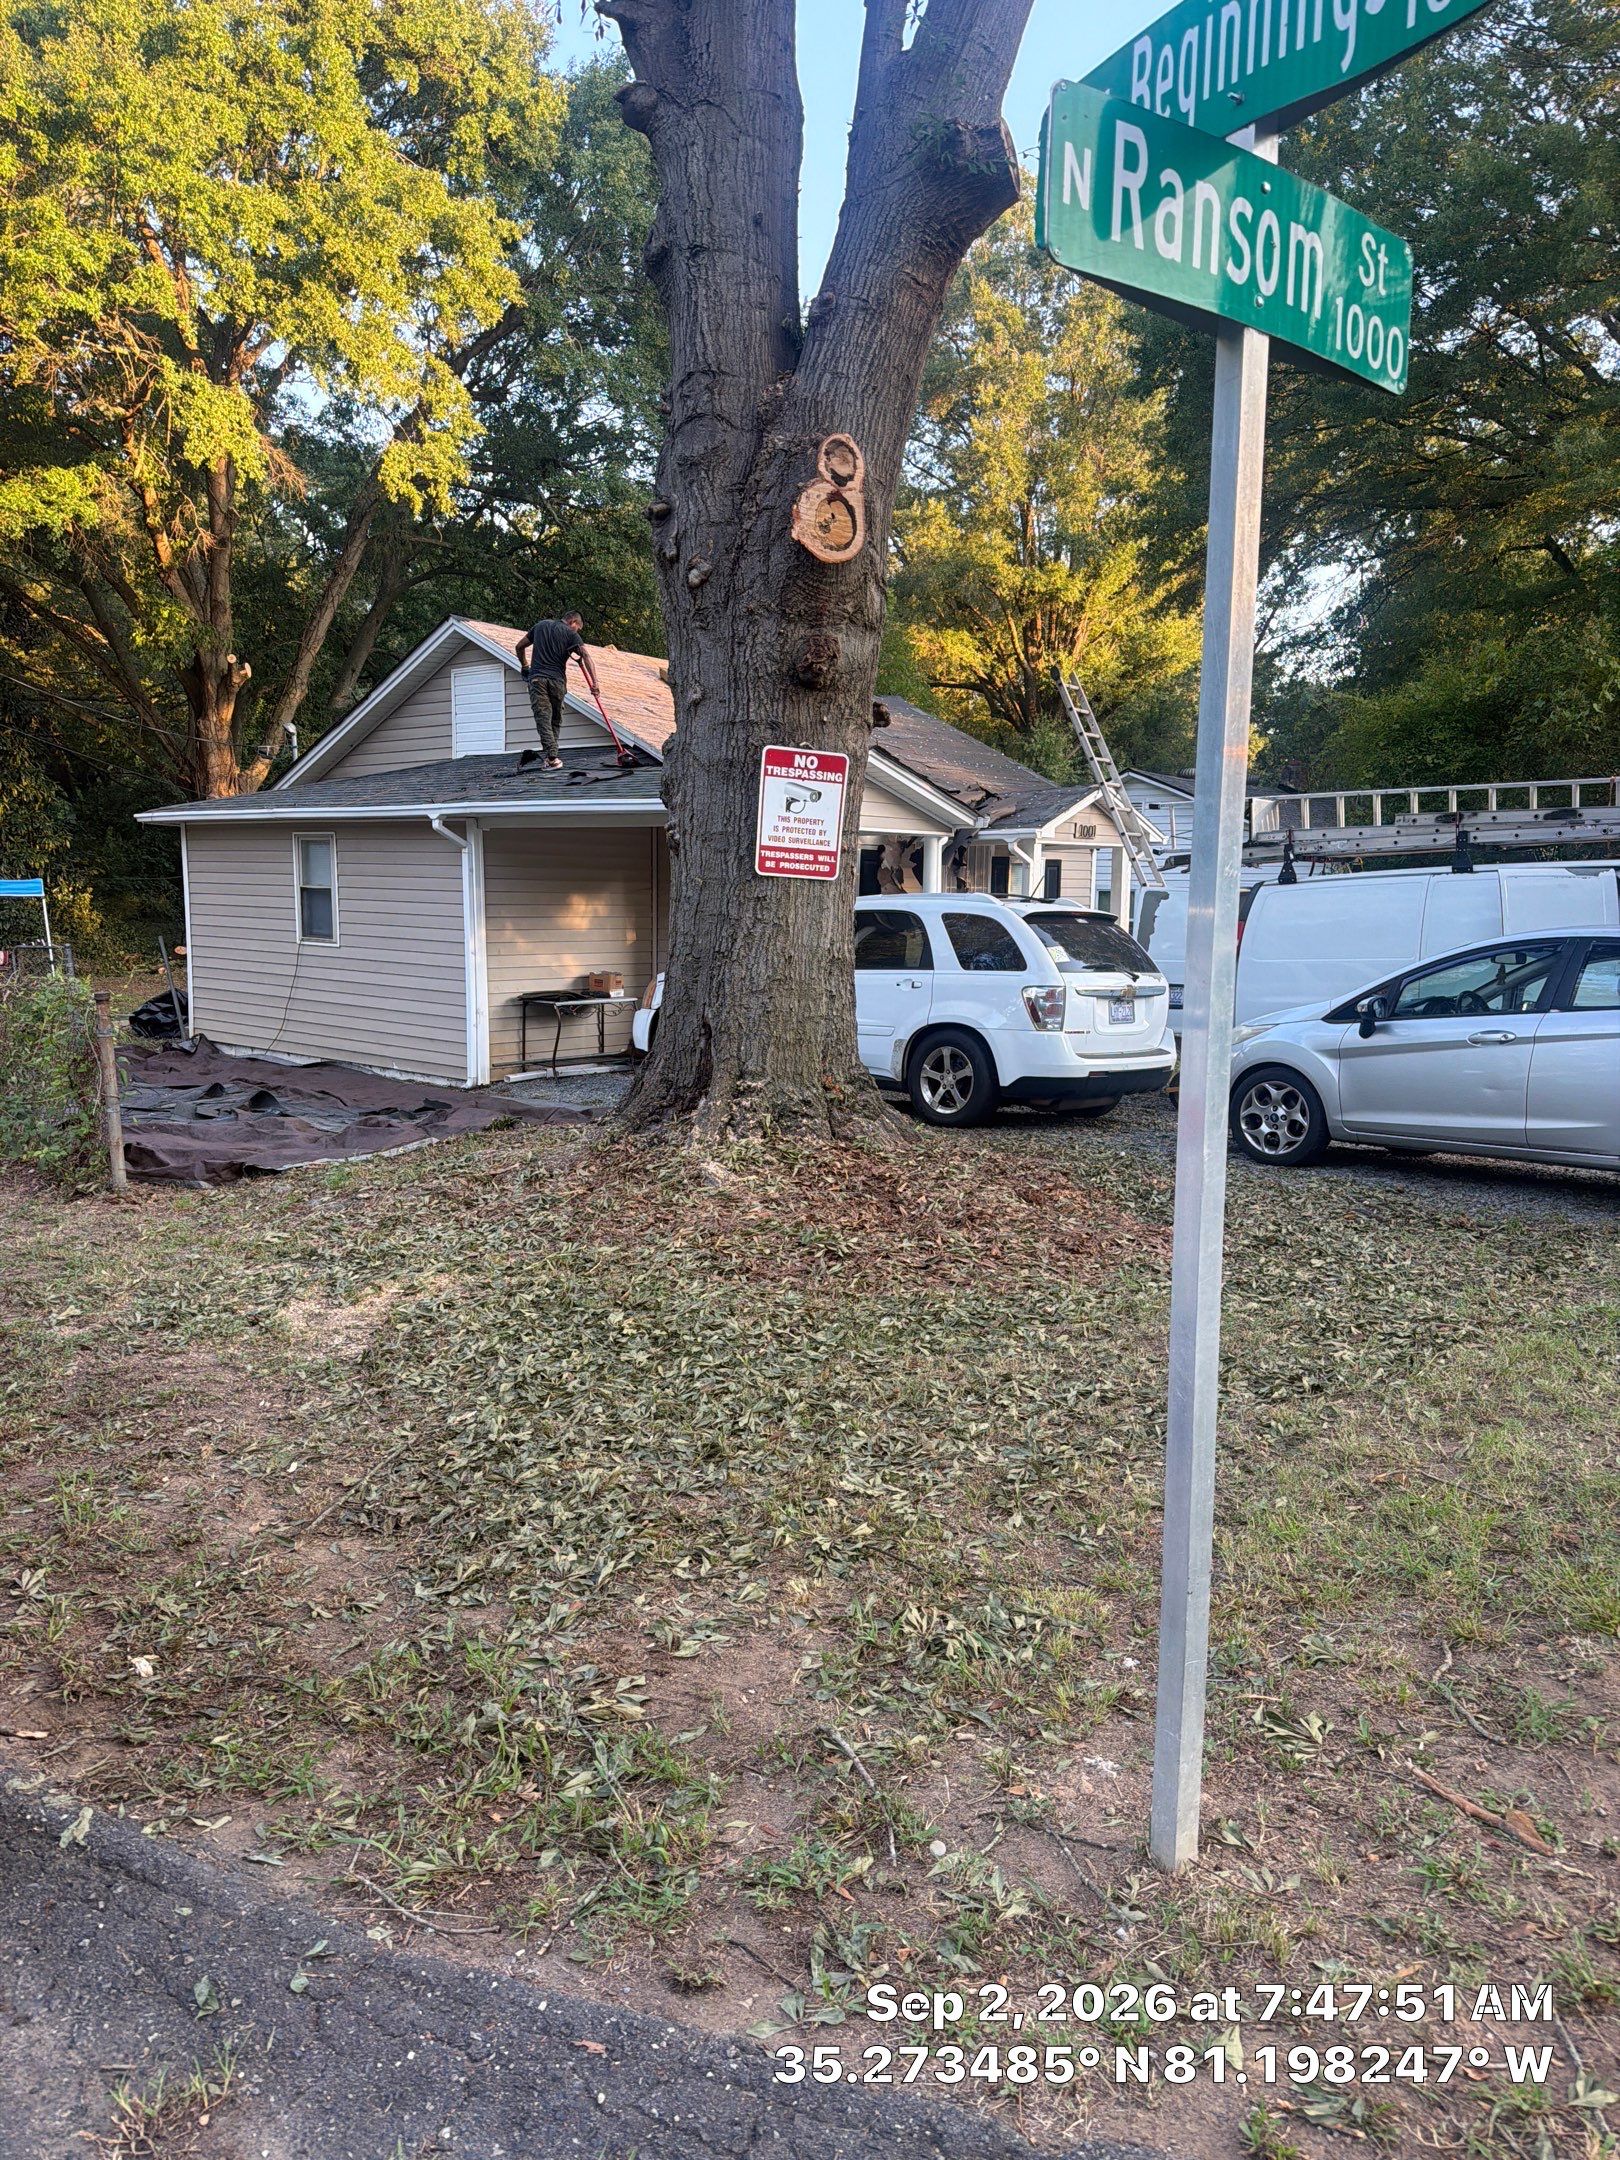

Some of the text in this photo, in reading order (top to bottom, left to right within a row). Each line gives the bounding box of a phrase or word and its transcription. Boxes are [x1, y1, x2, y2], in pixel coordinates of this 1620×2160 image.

[1131, 0, 1388, 128] Beginning
[1062, 119, 1389, 320] N Ransom St
[1335, 297, 1404, 380] 1000
[794, 754, 819, 769] NO
[766, 765, 843, 782] TRESPASSING
[777, 815, 825, 826] THIS PROPERTY
[782, 826, 817, 836] PROTECTED
[819, 829, 827, 837] BY
[768, 835, 831, 847] VIDEO SURVEILLANCE
[760, 850, 836, 863] TRESPASSERS WILL
[765, 860, 830, 872] BE PROSECUTED
